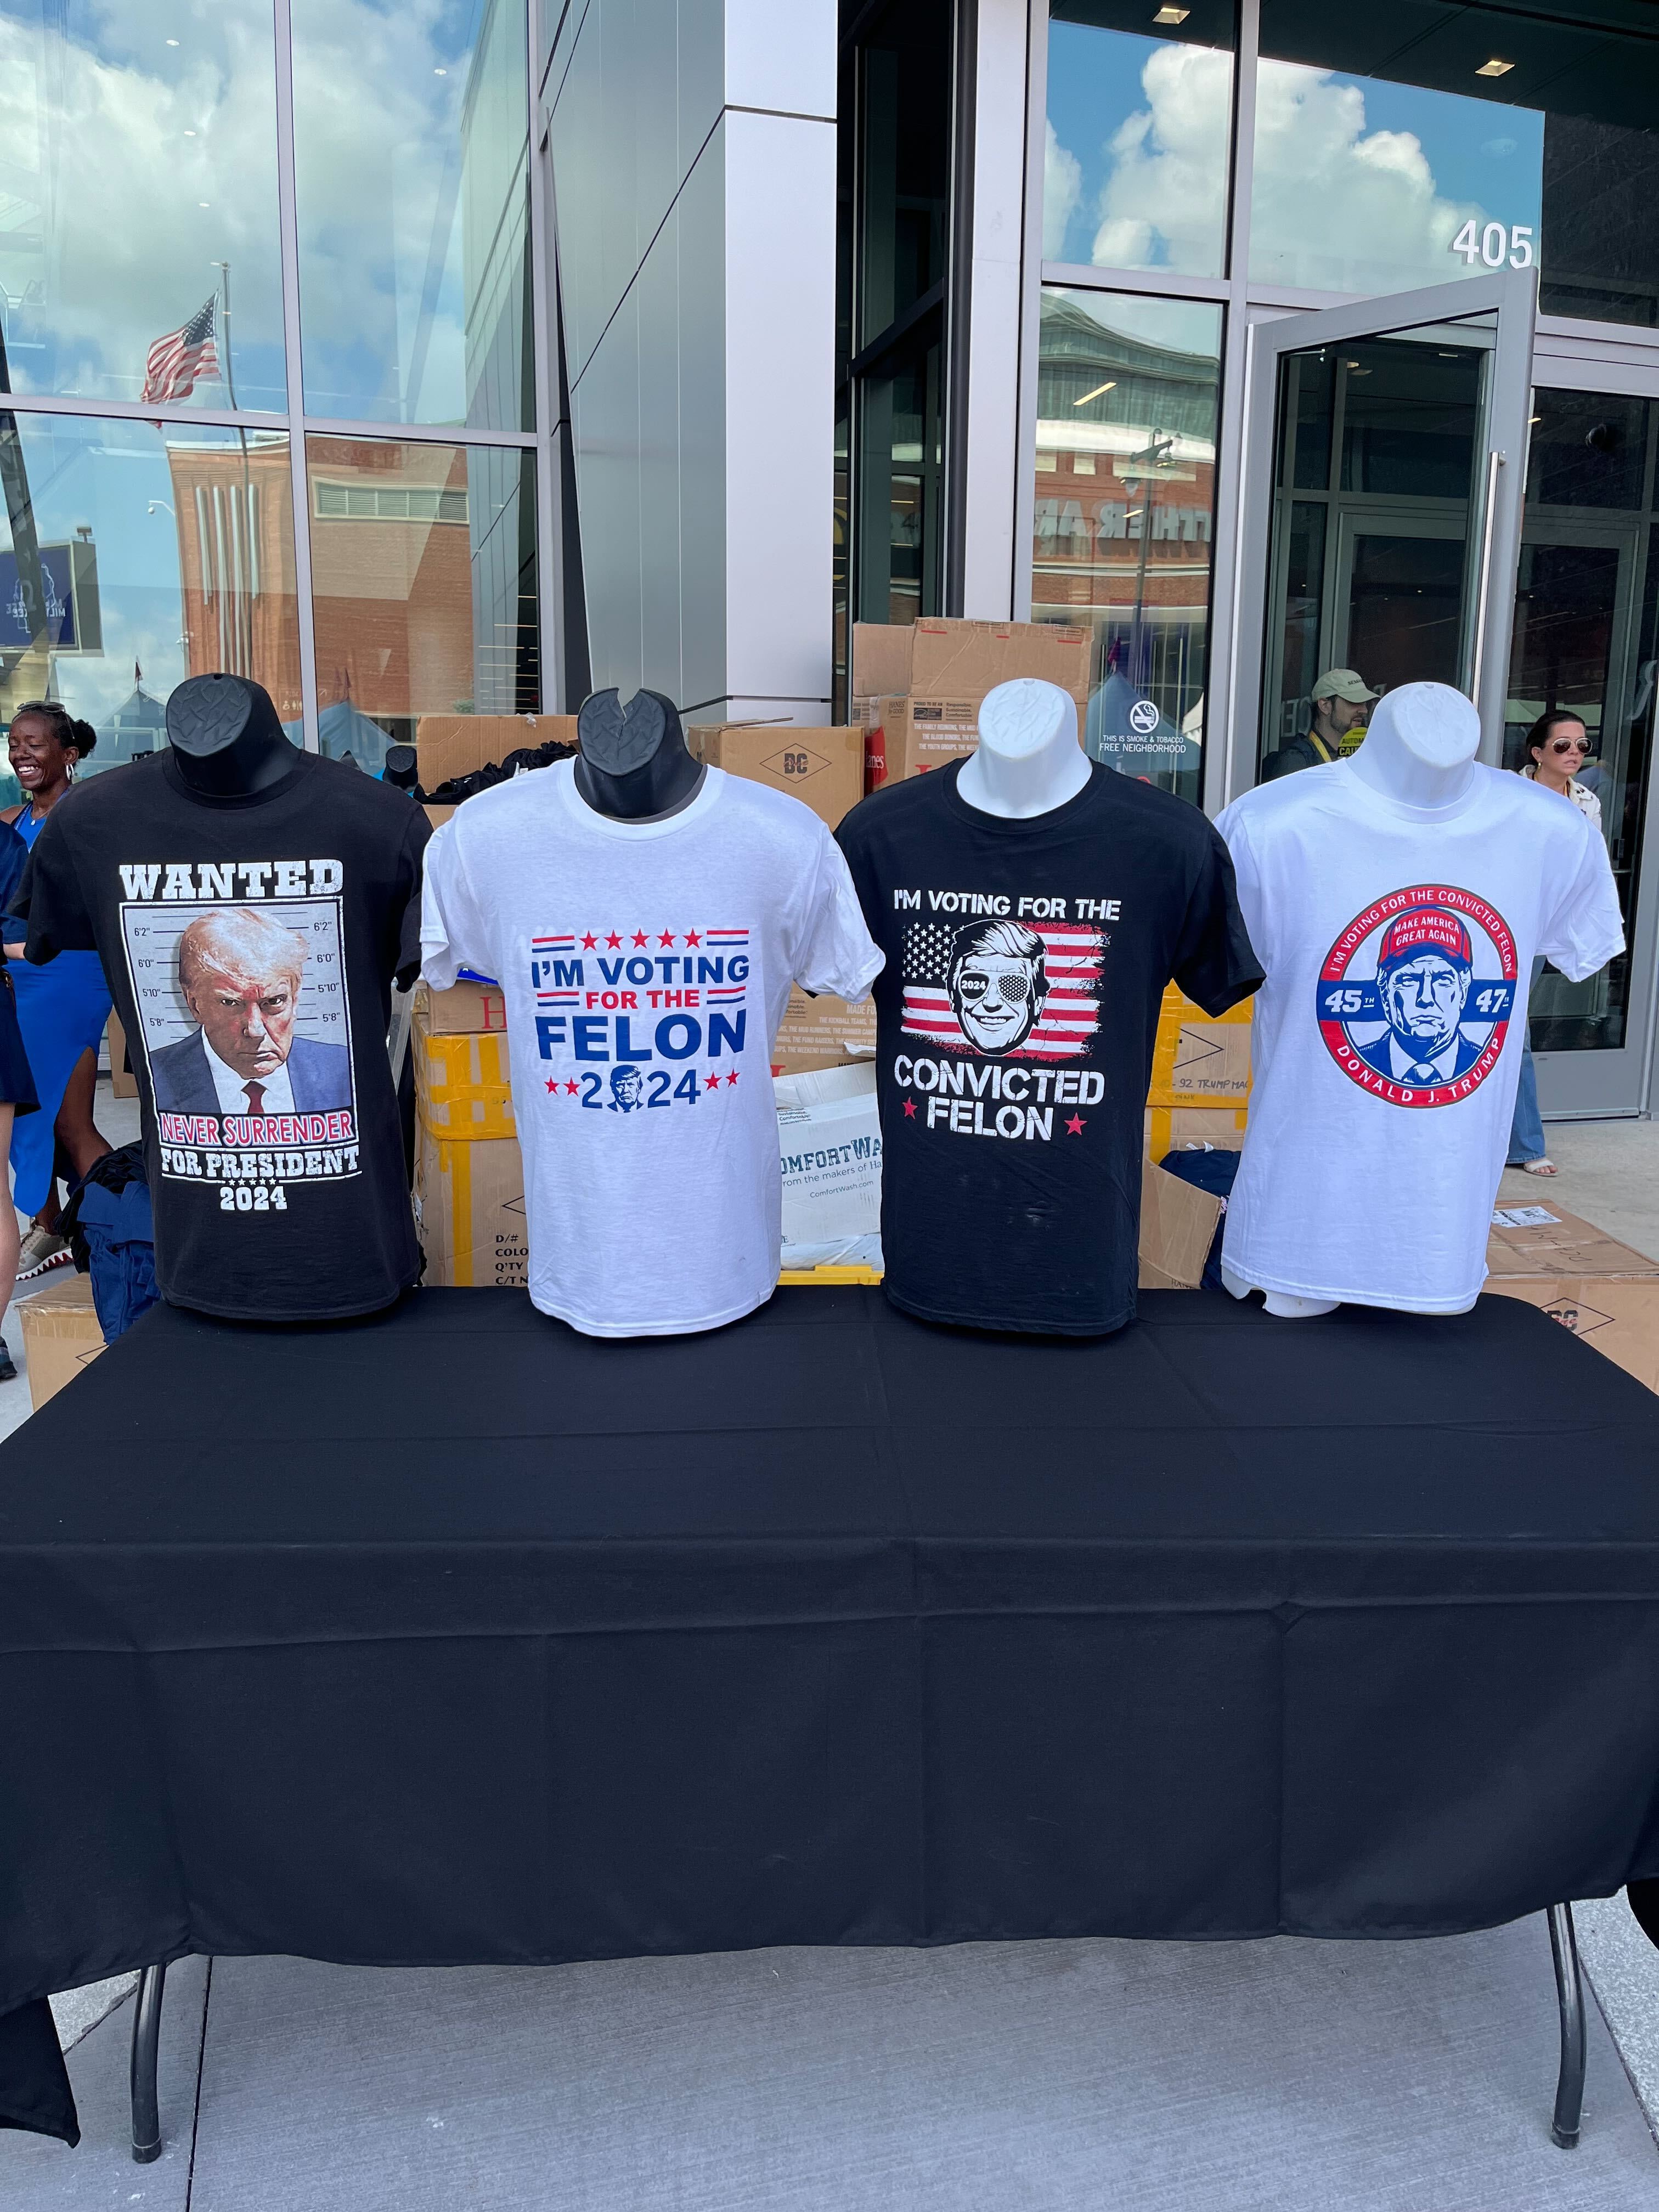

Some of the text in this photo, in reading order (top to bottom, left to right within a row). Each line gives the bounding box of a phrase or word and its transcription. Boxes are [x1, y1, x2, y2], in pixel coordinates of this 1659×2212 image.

[1453, 219, 1532, 269] 405
[1099, 743, 1187, 753] FREE NEIGHBORHOOD
[119, 859, 343, 900] WANTED
[894, 889, 1122, 921] I'M VOTING FOR THE
[134, 927, 150, 936] 6'2"
[314, 921, 332, 932] 6'2"
[1330, 890, 1512, 972] I'M VOTING FOR THE CONVICTED FELON
[1394, 916, 1460, 935] MAKE AMERICA
[1396, 929, 1457, 946] GREAT AGAIN
[138, 959, 154, 968] 6'0"
[317, 953, 336, 963] 6'0"
[532, 955, 749, 988] I'M VOTING
[143, 988, 161, 997] 5'10"
[318, 983, 340, 994] 5'10"
[961, 980, 986, 990] 2024
[586, 989, 700, 1009] FOR THE
[323, 1012, 341, 1022] 5'8"
[847, 1005, 866, 1014] MADE
[150, 1018, 165, 1027] 5'8"
[535, 1008, 747, 1062] FELON
[1337, 1037, 1499, 1103] DONALD J. TRUMP
[894, 1054, 1105, 1105] CONVICTED
[1179, 1078, 1193, 1088] 92
[1198, 1079, 1231, 1089] TRUMP
[927, 1096, 1054, 1141] FELON
[160, 1110, 354, 1146] NEVER SURRENDER
[161, 1144, 359, 1178] FOR PRESIDENT
[804, 1175, 820, 1183] the
[822, 1166, 855, 1180] makers
[857, 1163, 867, 1172] of
[810, 1180, 874, 1198] ComfortWash.com
[221, 1186, 287, 1210] 2024
[496, 1234, 518, 1243] D/#
[495, 1262, 523, 1272] Q'TY
[495, 1276, 516, 1285] C/T
